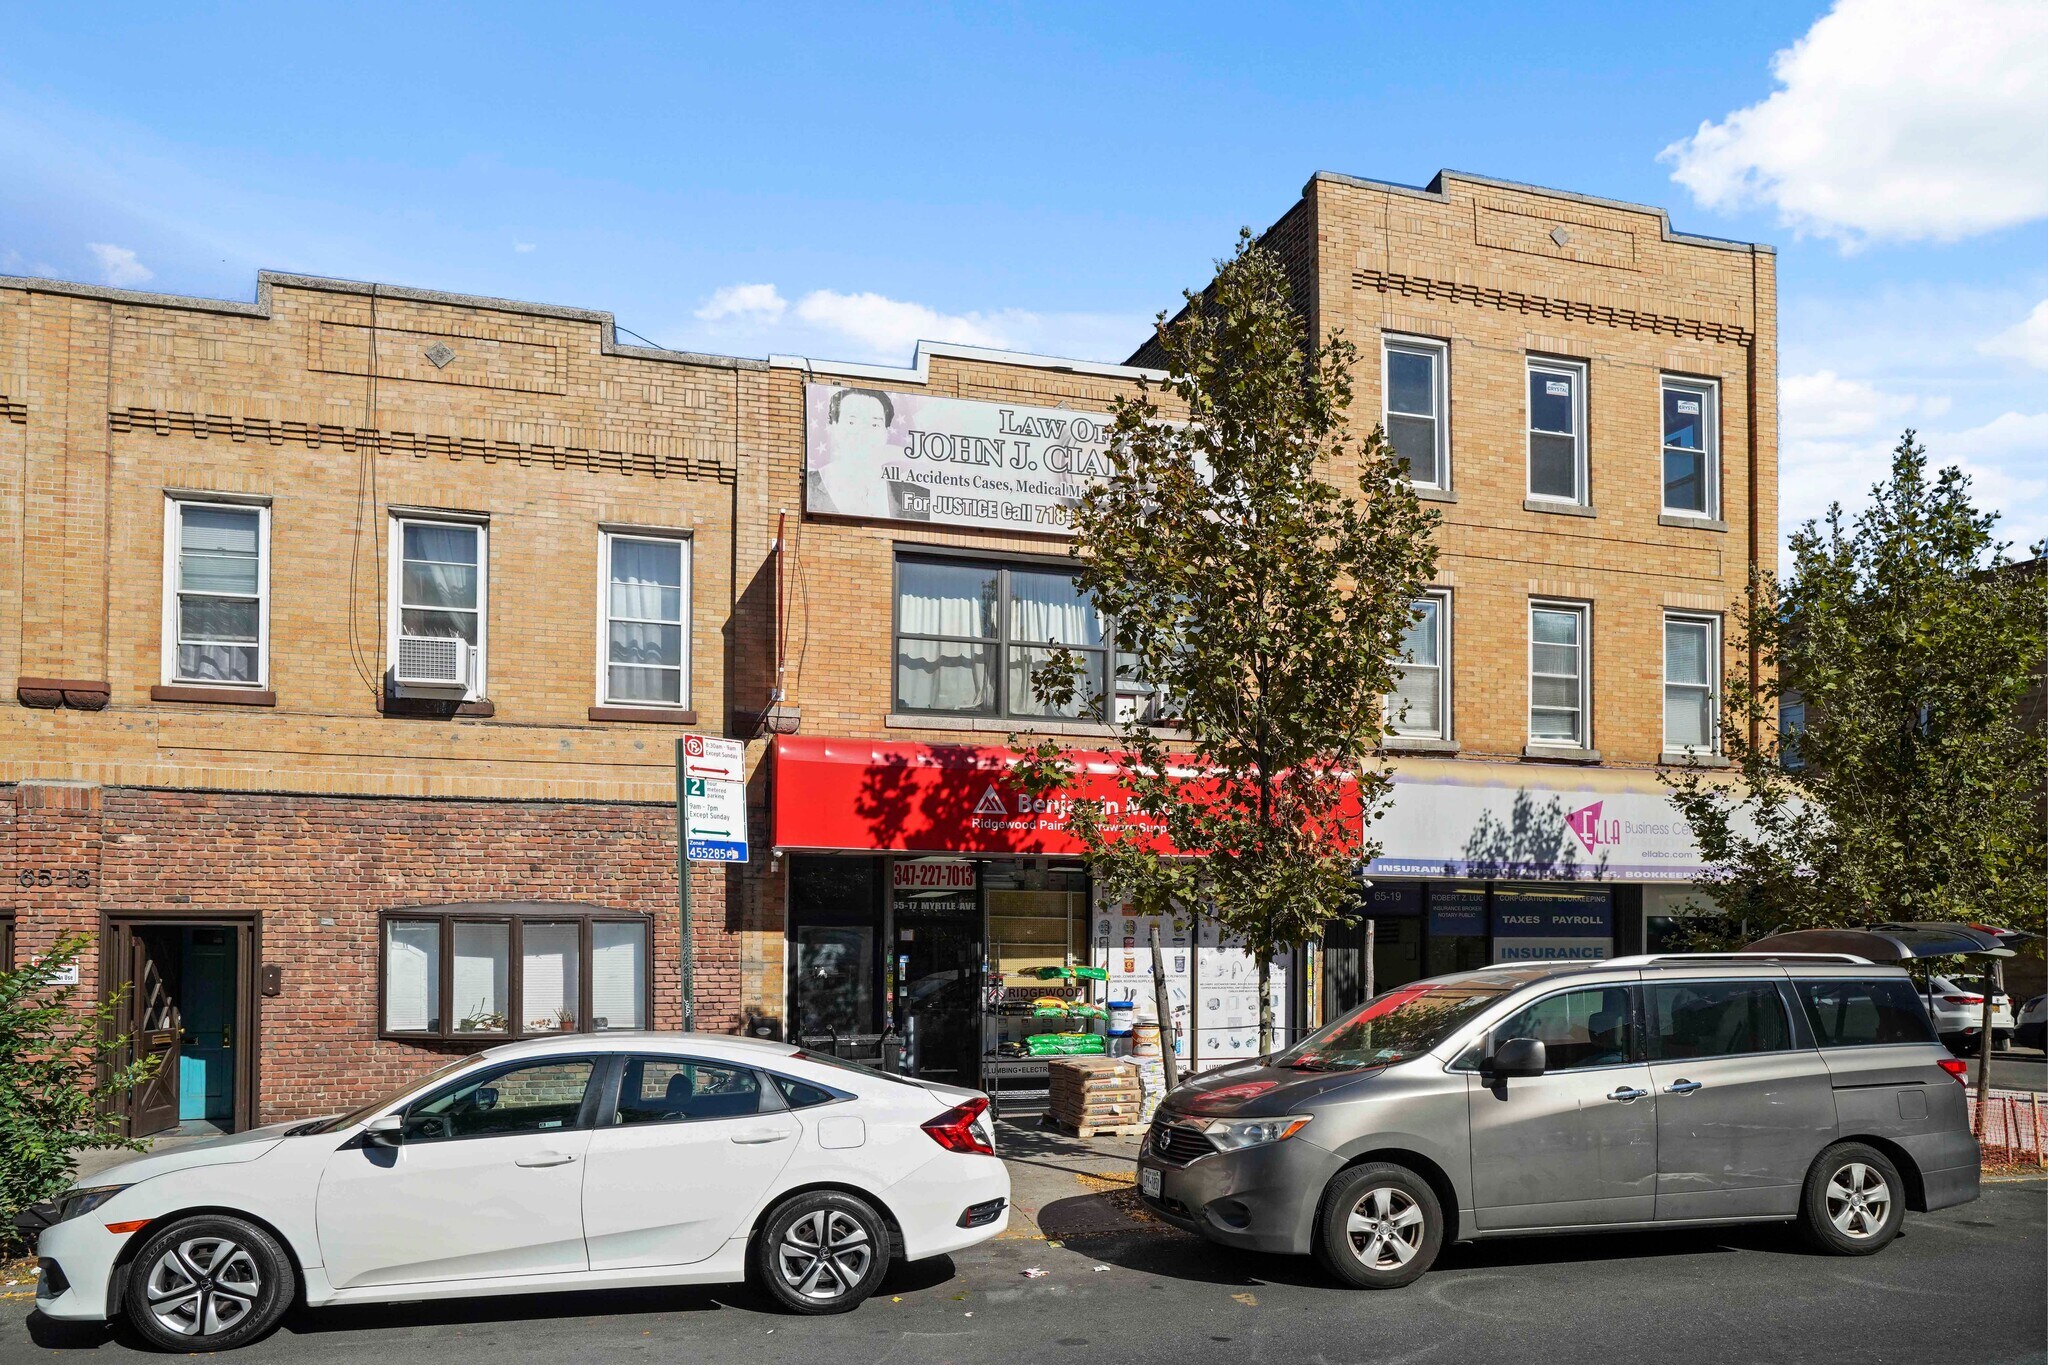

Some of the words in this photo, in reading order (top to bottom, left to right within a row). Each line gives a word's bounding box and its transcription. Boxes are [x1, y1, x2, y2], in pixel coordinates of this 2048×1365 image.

[1000, 409, 1066, 440] LAW
[904, 430, 1005, 468] JOHN
[1010, 441, 1038, 471] J.
[881, 466, 900, 481] All
[905, 468, 970, 487] Accidents
[972, 475, 1013, 492] Cases,
[1016, 479, 1066, 497] Medical
[902, 491, 930, 513] For
[932, 495, 998, 519] JUSTICE
[1000, 501, 1032, 522] Call
[1036, 505, 1074, 526] 718-
[690, 779, 701, 795] 2
[689, 802, 702, 810] 9am
[708, 804, 719, 812] 7pm
[689, 811, 709, 819] Except
[710, 812, 730, 821] Sunday
[971, 818, 1036, 832] Ridgewood
[1579, 810, 1621, 845] ELLA
[1625, 820, 1669, 835] Business
[689, 847, 726, 859] 455285
[1641, 850, 1693, 859] ellabc.com
[20, 868, 91, 888] 65-13
[894, 864, 974, 886] 347-227-7013
[1374, 891, 1401, 901] 65-19
[921, 902, 956, 910] MYRTLE
[959, 902, 976, 910] AVE
[1502, 915, 1540, 924] TAXES
[1552, 916, 1603, 924] PAYROLL
[1501, 947, 1604, 959] INSURANCE
[1008, 987, 1083, 998] RIDGEWOOD
